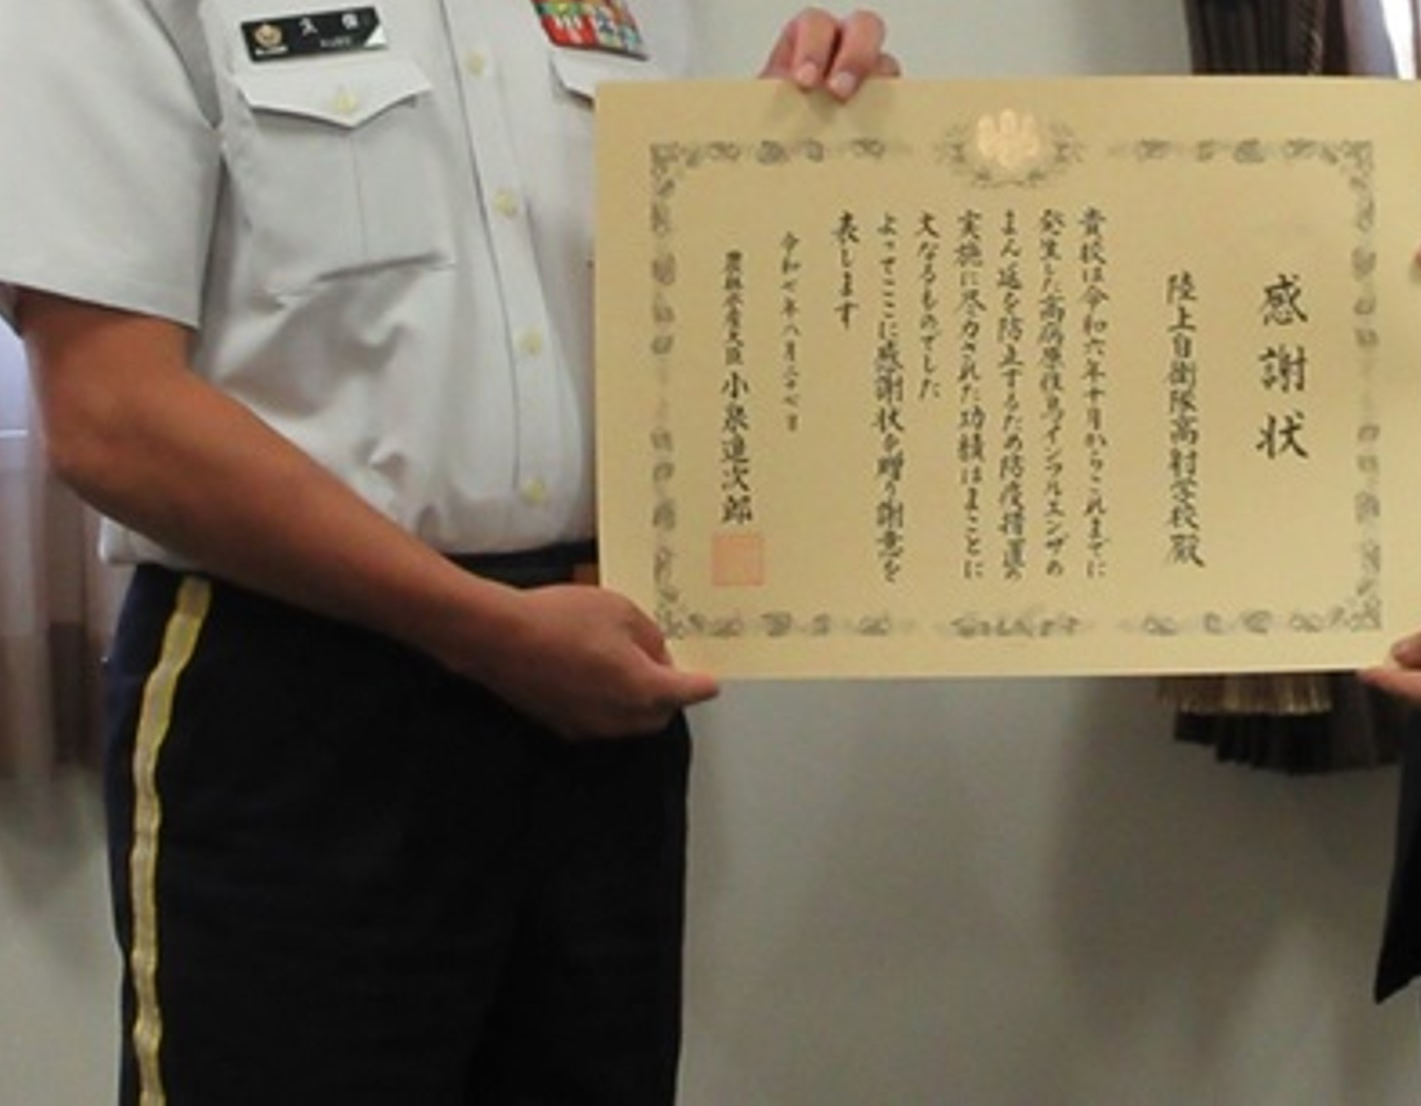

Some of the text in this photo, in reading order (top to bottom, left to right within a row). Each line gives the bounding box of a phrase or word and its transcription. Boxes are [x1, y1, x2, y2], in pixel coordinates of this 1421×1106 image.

[834, 211, 859, 329] 表します
[1167, 271, 1204, 567] 陸上自衛隊高射学校殿
[1256, 274, 1308, 459] 感謝状
